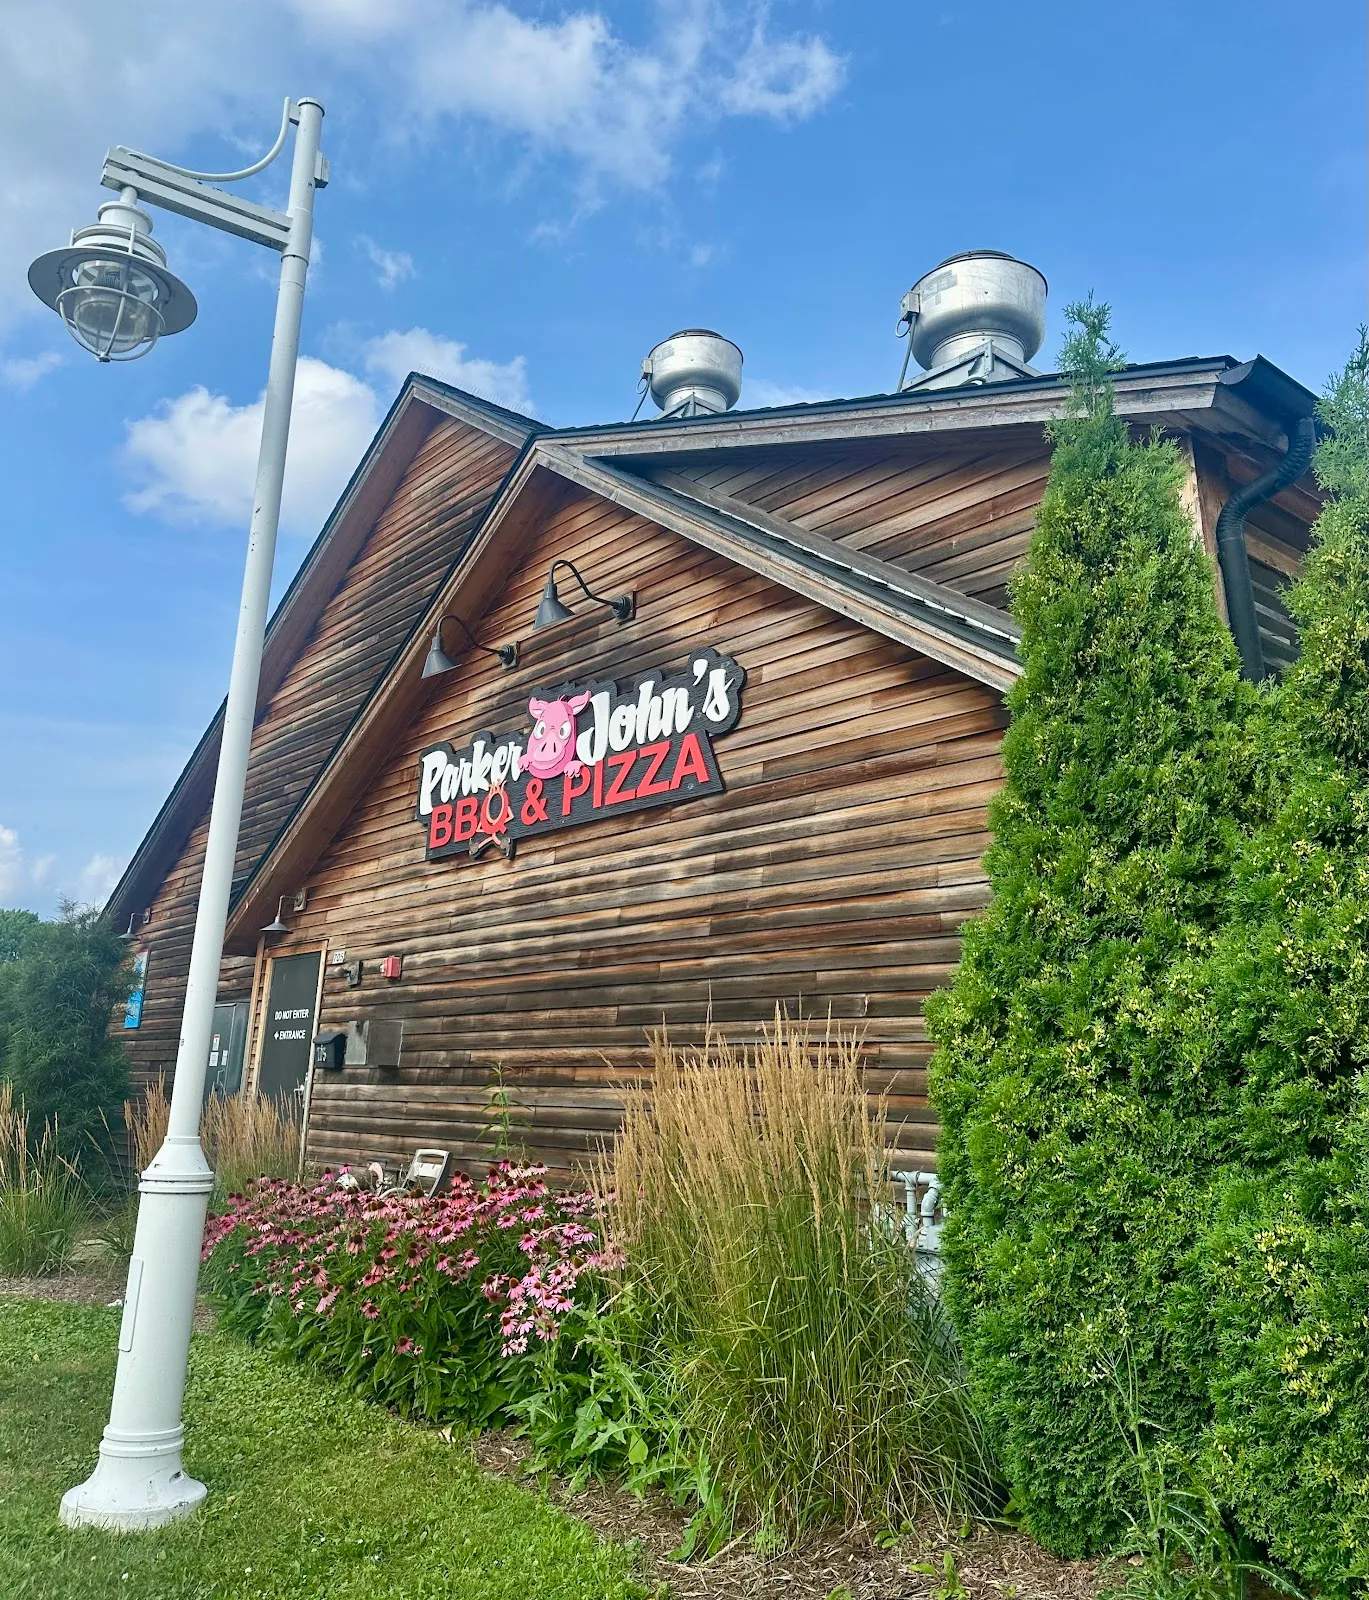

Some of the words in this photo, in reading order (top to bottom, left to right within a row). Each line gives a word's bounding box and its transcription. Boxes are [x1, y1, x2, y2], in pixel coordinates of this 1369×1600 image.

[420, 741, 524, 815] Parker
[576, 658, 735, 766] John's
[429, 785, 508, 848] BBQ
[521, 779, 548, 826] &
[562, 733, 710, 817] PIZZA
[274, 1010, 282, 1020] DO
[282, 1010, 292, 1019] NOT
[292, 1009, 309, 1019] ENTER
[280, 1030, 306, 1040] ENTRANCE
